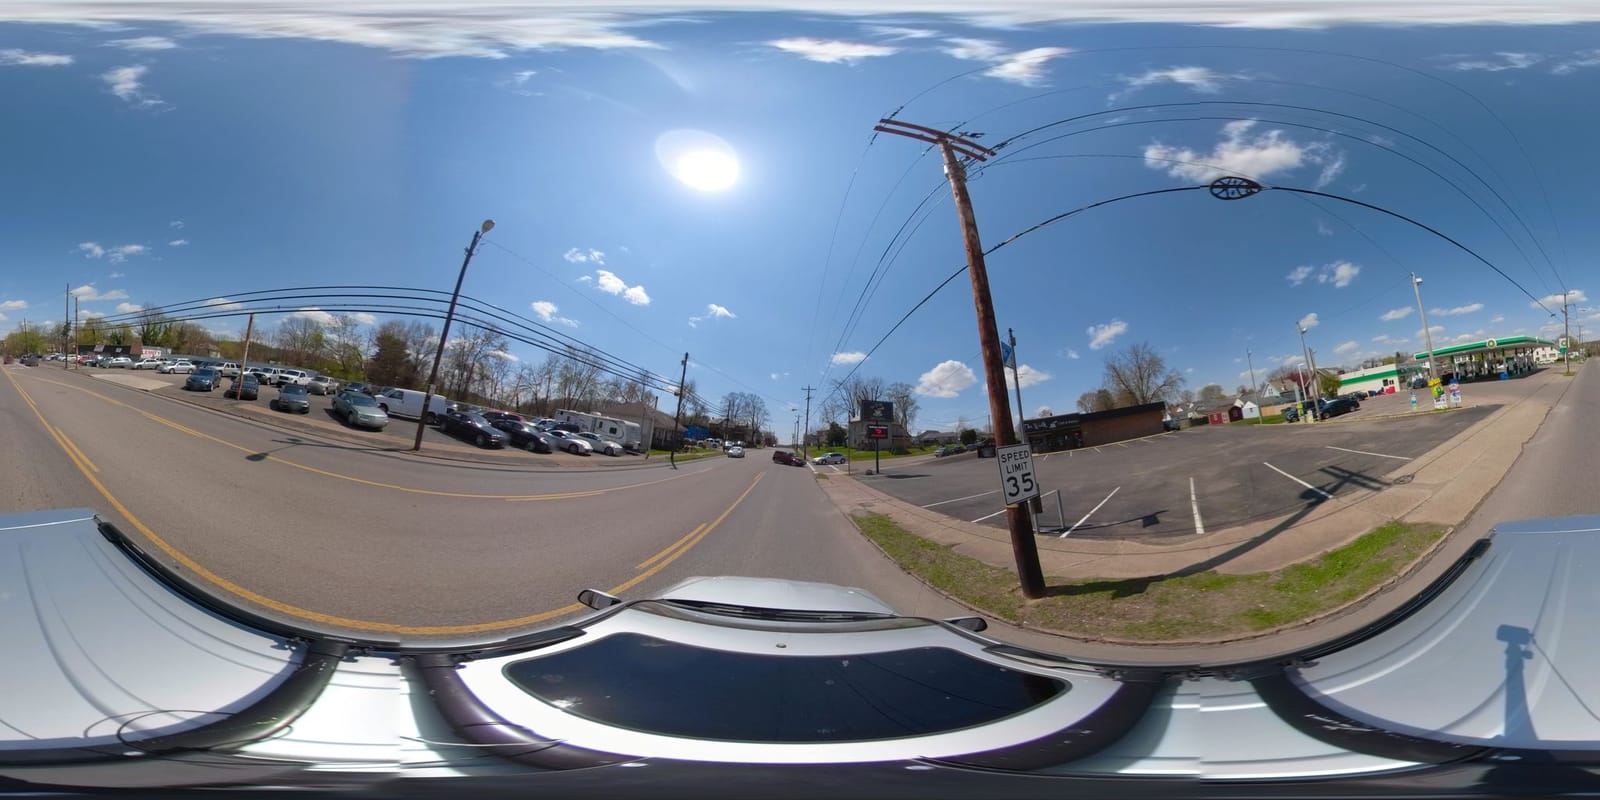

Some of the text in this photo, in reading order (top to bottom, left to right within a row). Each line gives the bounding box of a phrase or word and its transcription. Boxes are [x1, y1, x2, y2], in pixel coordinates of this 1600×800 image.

[1001, 450, 1029, 462] SPEED
[1006, 461, 1027, 473] LIMIT
[1007, 472, 1033, 497] 35
